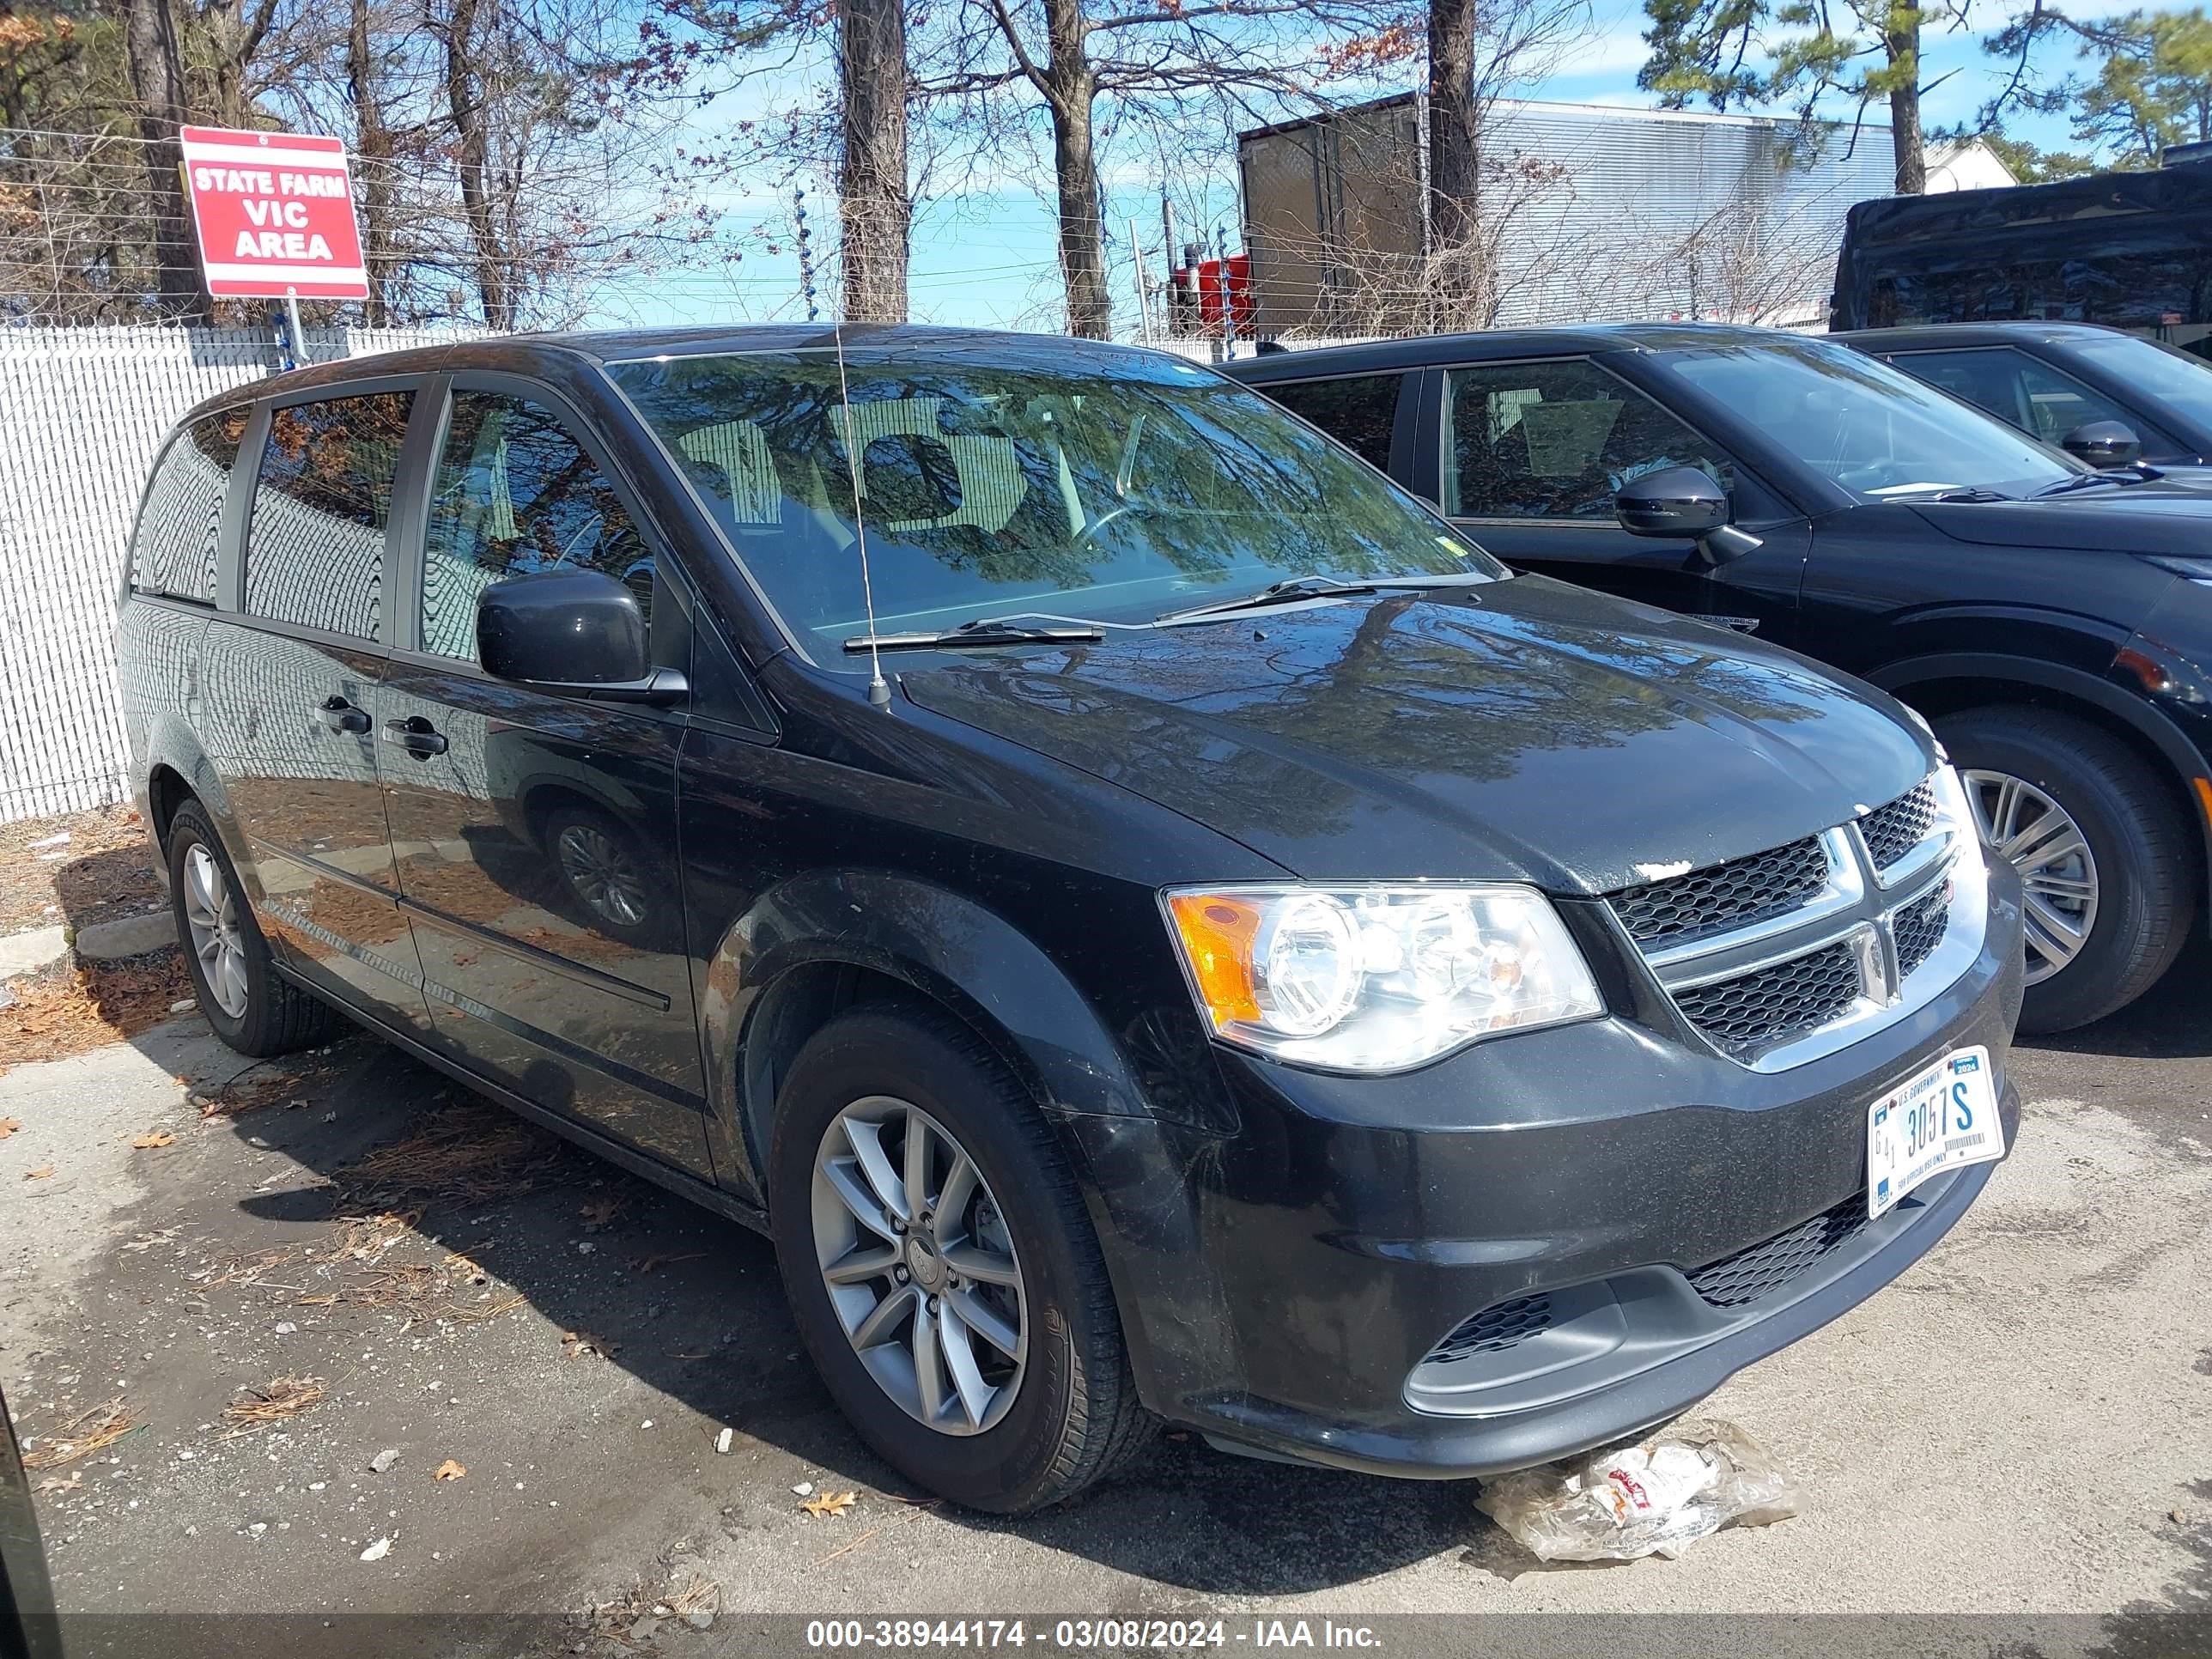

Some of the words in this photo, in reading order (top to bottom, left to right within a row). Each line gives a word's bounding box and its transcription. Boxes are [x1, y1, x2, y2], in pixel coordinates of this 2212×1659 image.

[194, 167, 275, 195] STATE
[279, 173, 347, 198] FARM
[242, 198, 309, 228] VIC
[234, 231, 333, 260] AREA
[1957, 1062, 1977, 1073] 2024
[1899, 1091, 1909, 1107] U.S.
[1910, 1067, 1943, 1099] GOVERNMENT
[1933, 1152, 1947, 1165] ONLY
